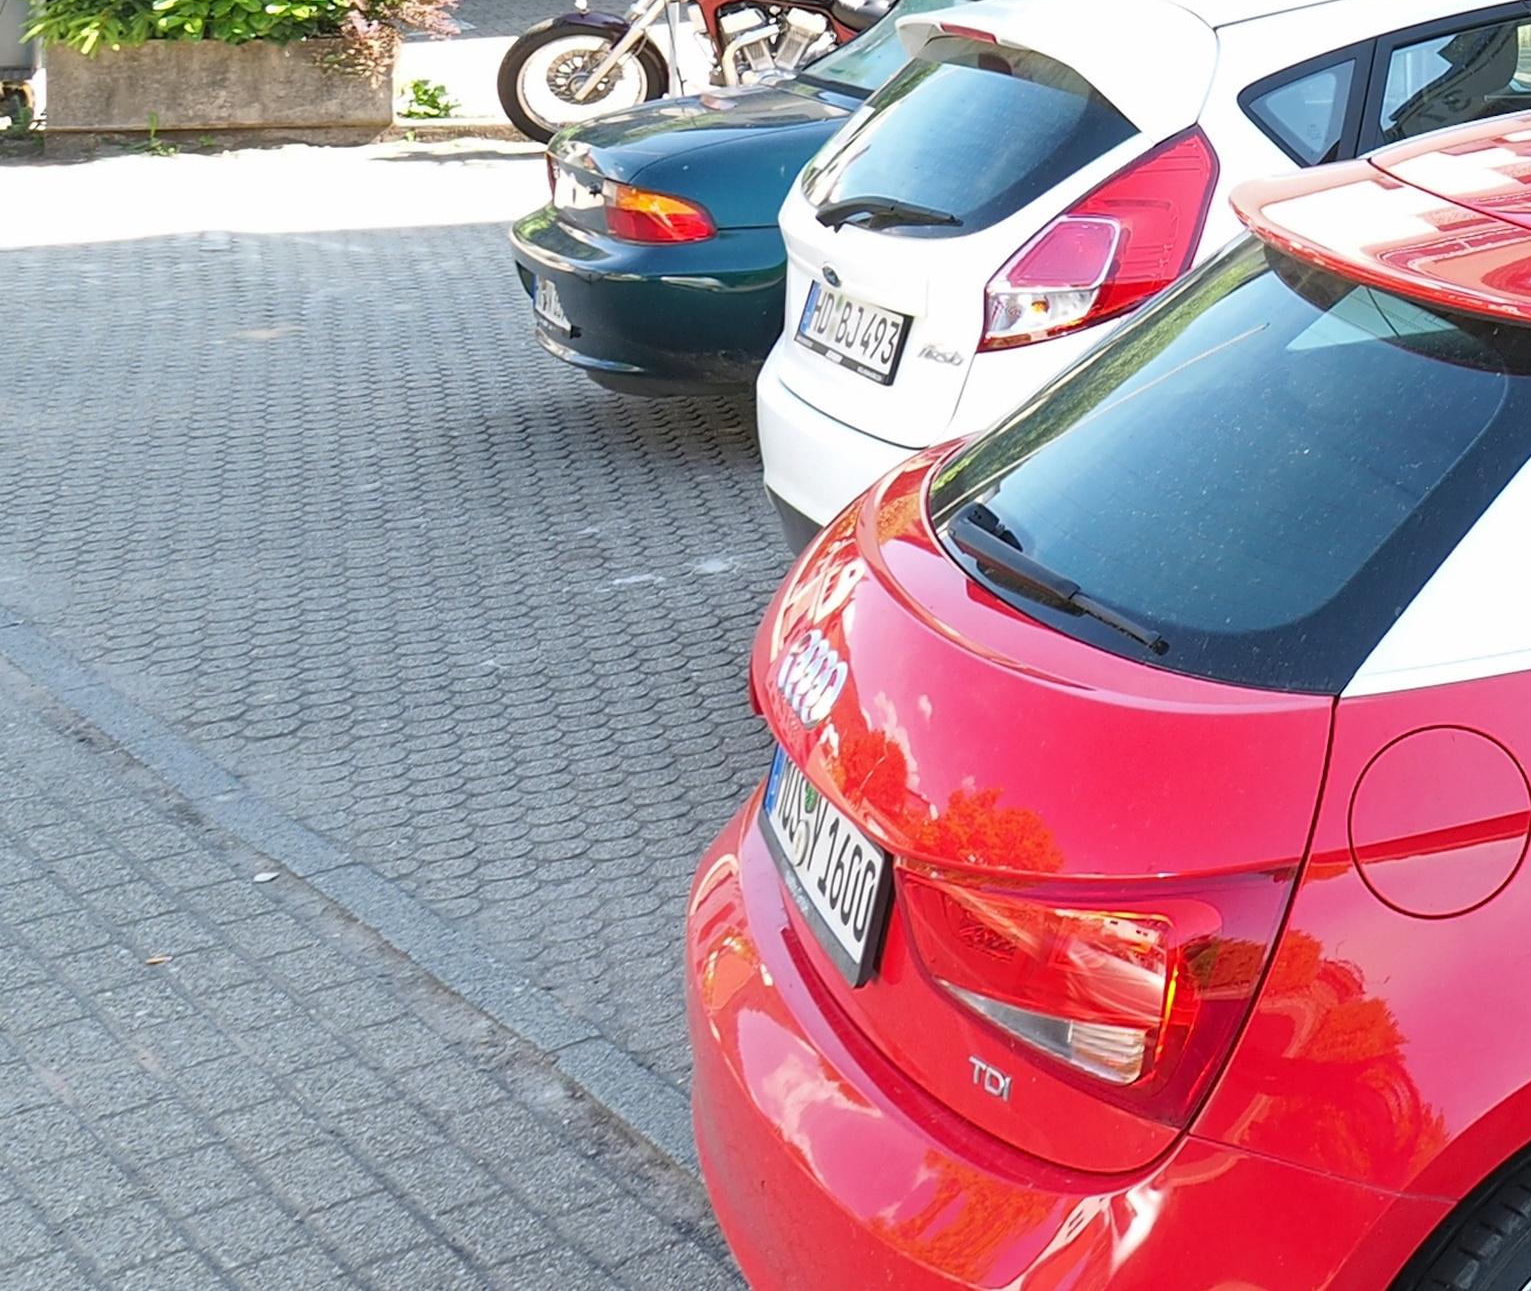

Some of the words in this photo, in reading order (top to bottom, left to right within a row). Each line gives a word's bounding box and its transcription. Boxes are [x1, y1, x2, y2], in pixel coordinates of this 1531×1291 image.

[813, 292, 835, 334] HD
[835, 301, 864, 348] BJ
[860, 314, 900, 365] 493
[817, 817, 876, 943] 1600
[969, 1055, 1011, 1102] TDI
